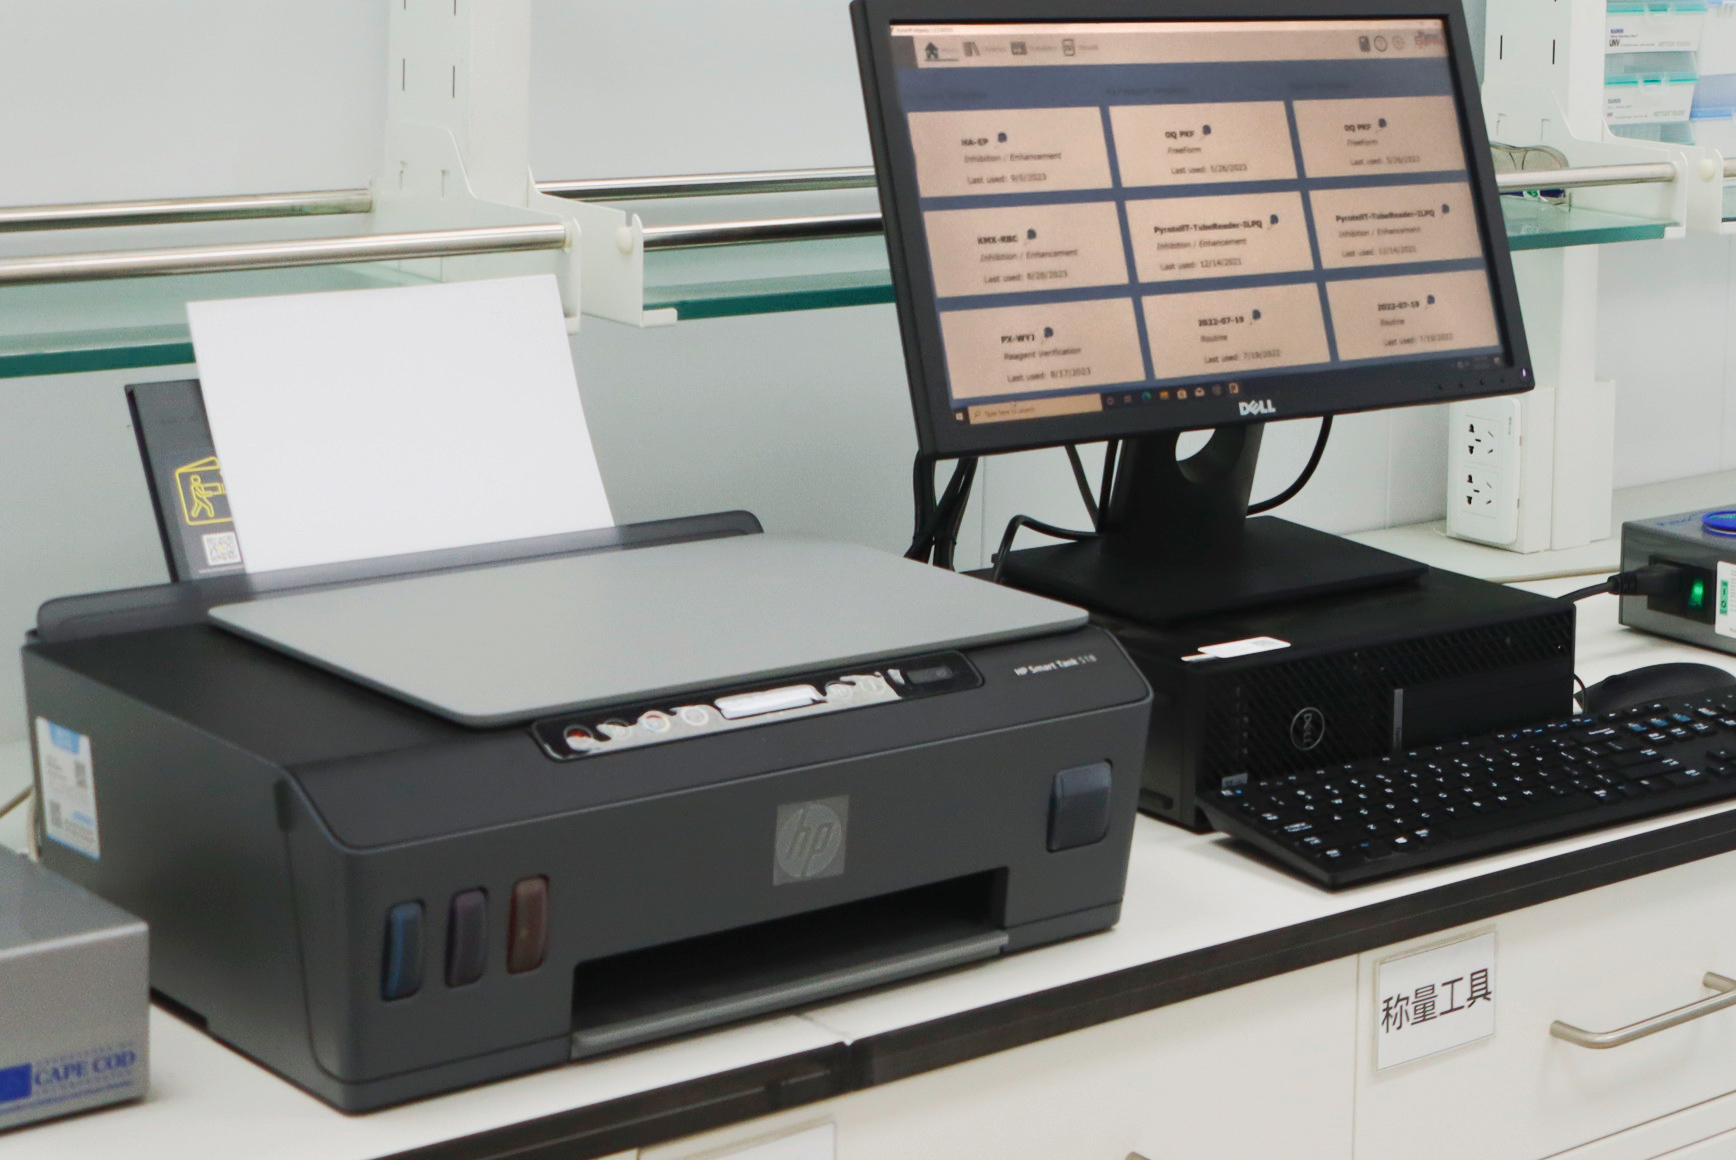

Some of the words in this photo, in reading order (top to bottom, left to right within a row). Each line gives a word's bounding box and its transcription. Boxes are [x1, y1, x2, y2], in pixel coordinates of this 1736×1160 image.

[964, 153, 1001, 163] Inhibition
[1009, 152, 1062, 161] Enhancement
[1171, 167, 1187, 175] Last
[967, 176, 985, 184] Last
[1157, 240, 1191, 251] Inhibition
[1199, 238, 1247, 248] Enhancement
[980, 252, 1017, 263] Inhibition
[1026, 249, 1078, 259] Enhancement
[983, 275, 1000, 284] Last
[1004, 350, 1036, 361] Reagent
[1039, 347, 1082, 358] Verification
[1007, 374, 1024, 383] Last
[1238, 399, 1276, 416] DELL
[1014, 666, 1028, 676] HP
[1028, 662, 1057, 674] Smart
[1381, 968, 1492, 1033] 称量工具
[35, 1061, 88, 1086] CAPE
[92, 1050, 136, 1073] COD
